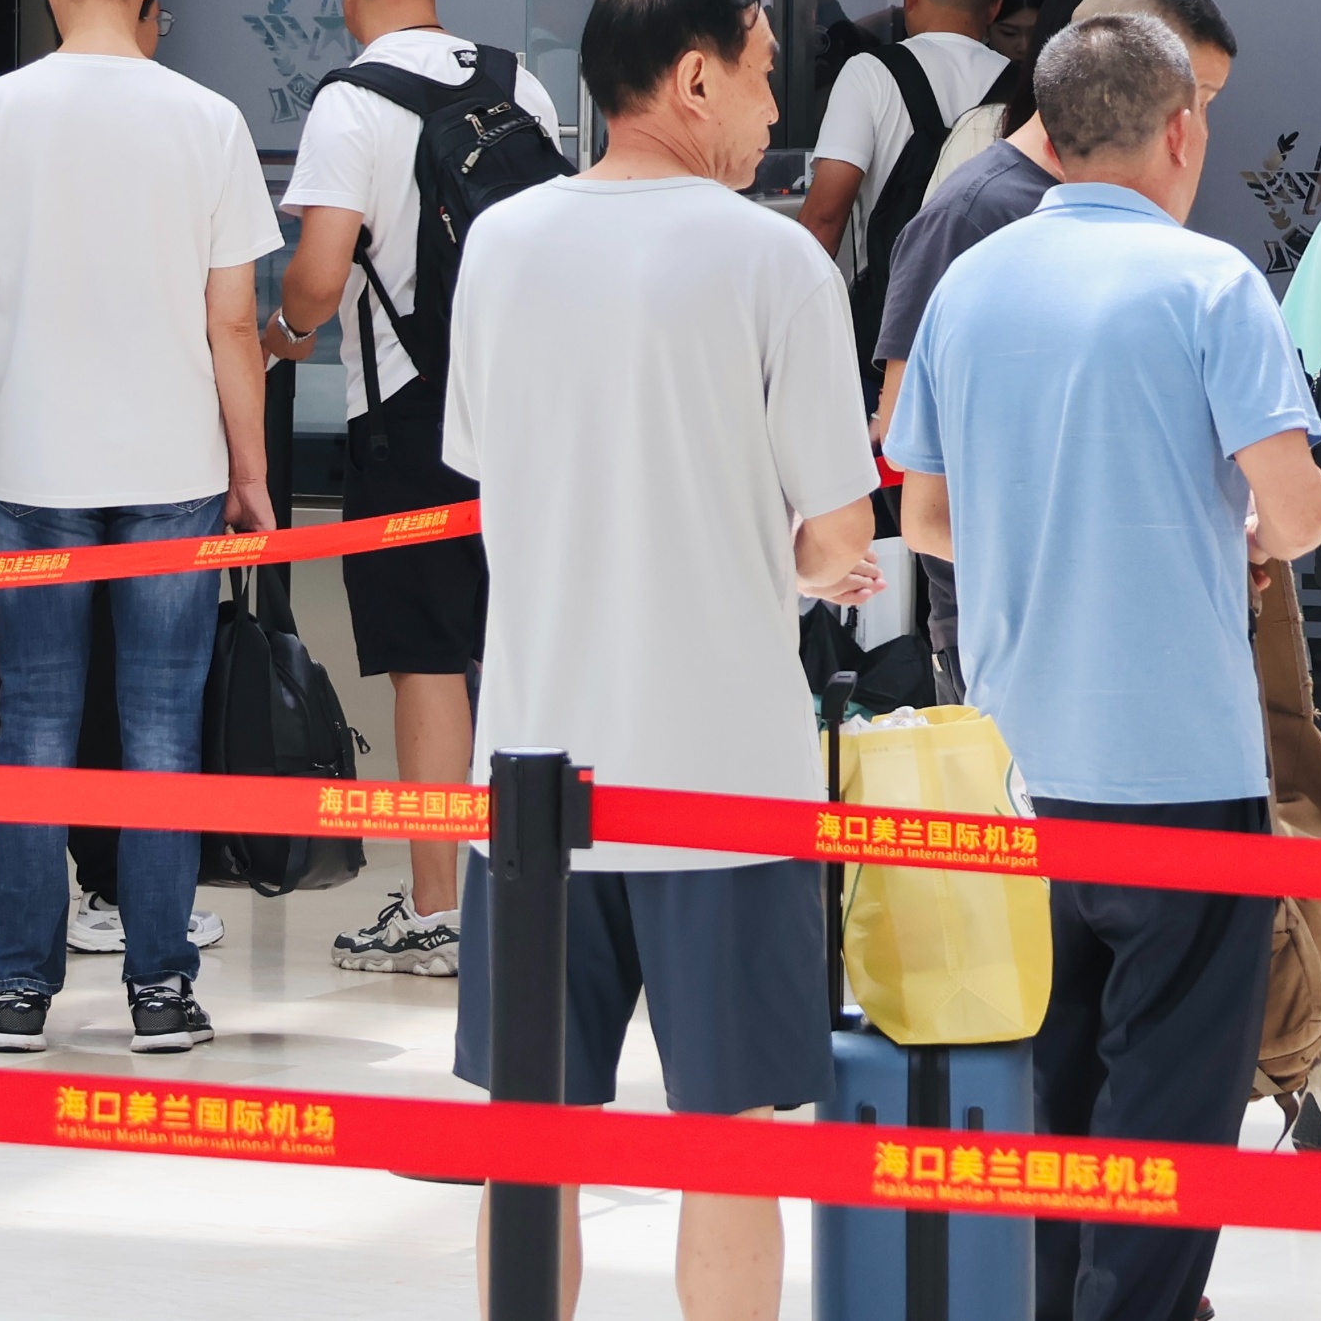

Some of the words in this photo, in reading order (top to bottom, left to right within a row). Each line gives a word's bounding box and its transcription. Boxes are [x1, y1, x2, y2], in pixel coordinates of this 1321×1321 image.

[815, 841, 860, 855] Haikou
[862, 845, 905, 859] Meilan
[907, 848, 992, 864] International
[993, 853, 1039, 868] Airport
[816, 813, 1038, 853] 海口美兰国际机场
[56, 1087, 335, 1140] 海口美兰国际机场
[874, 1142, 1177, 1195] 海口美兰国际机场
